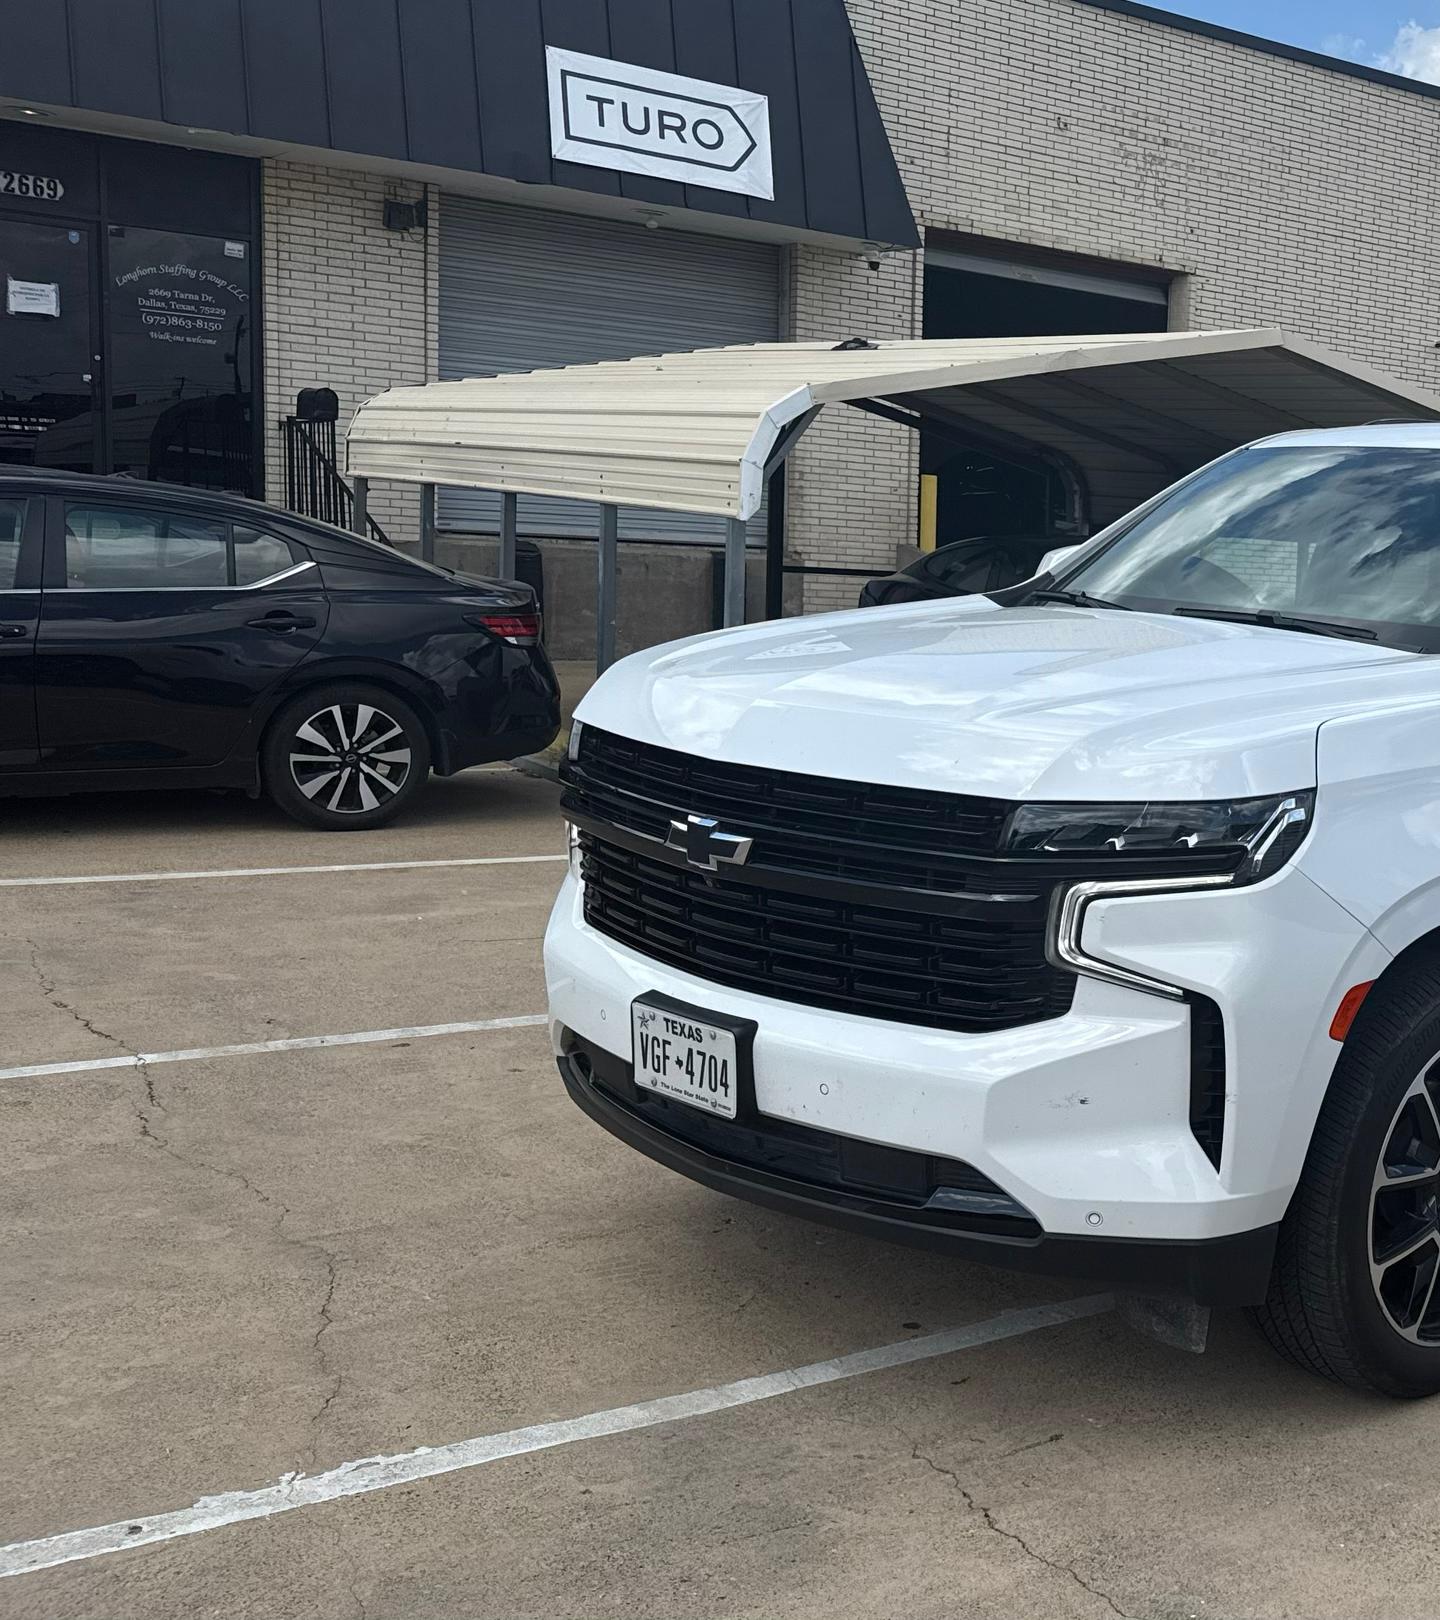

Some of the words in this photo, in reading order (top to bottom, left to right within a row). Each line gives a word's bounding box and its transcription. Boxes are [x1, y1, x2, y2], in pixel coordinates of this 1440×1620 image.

[586, 94, 724, 150] TURO
[3, 172, 58, 198] 2669
[116, 266, 157, 287] Longhorn
[159, 264, 197, 278] Staffing
[199, 270, 228, 287] Group
[227, 283, 249, 302] LLC
[148, 288, 171, 298] 2669
[138, 297, 168, 309] Dallas,
[169, 301, 198, 312] Texas,
[200, 305, 226, 316] 75229
[142, 313, 222, 331] (972)863-8150
[663, 1017, 703, 1043] TEXAS
[640, 1032, 671, 1076] VGF
[685, 1047, 729, 1097] 4704
